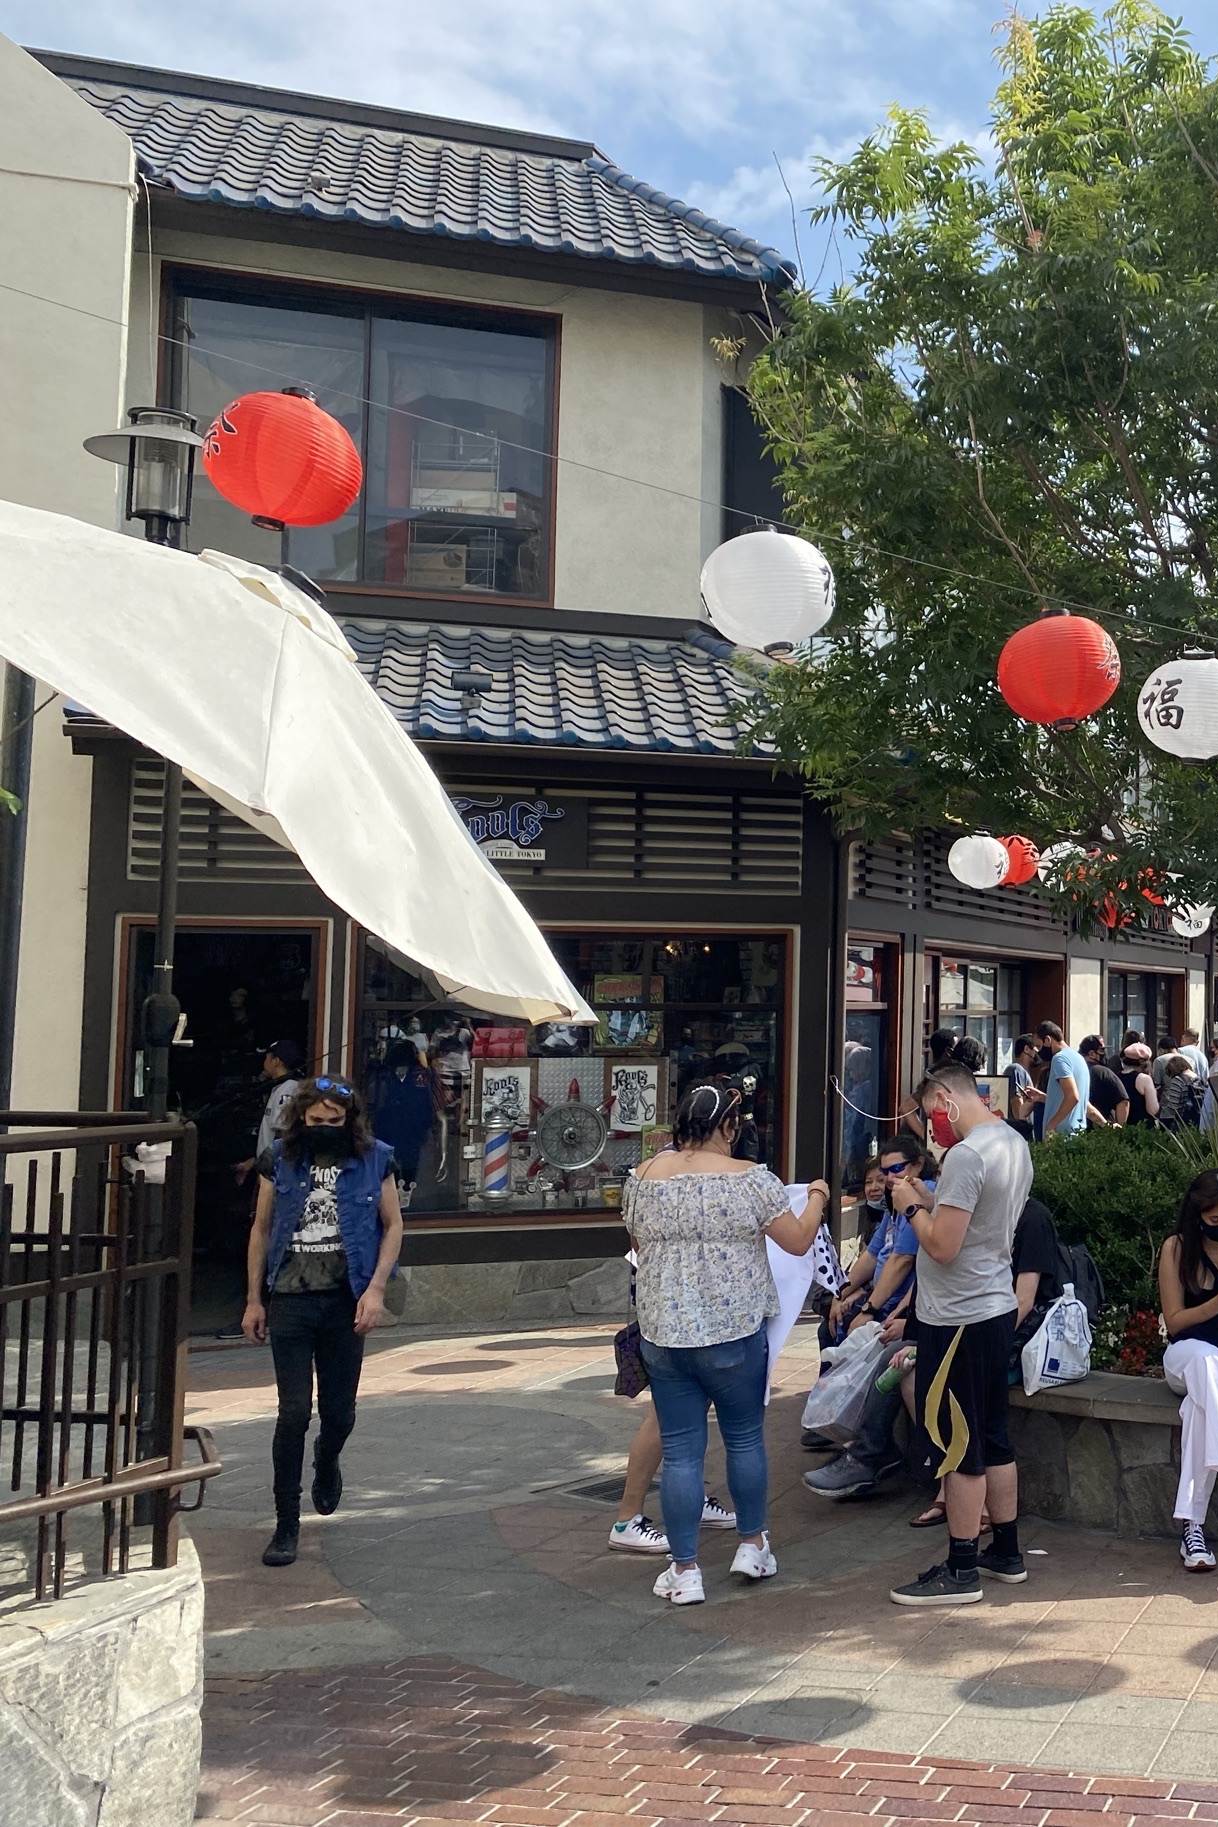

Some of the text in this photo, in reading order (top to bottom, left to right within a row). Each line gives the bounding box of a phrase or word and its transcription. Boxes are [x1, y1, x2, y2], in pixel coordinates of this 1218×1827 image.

[1142, 678, 1184, 731] 福
[486, 849, 542, 858] LITTLE TOKYO
